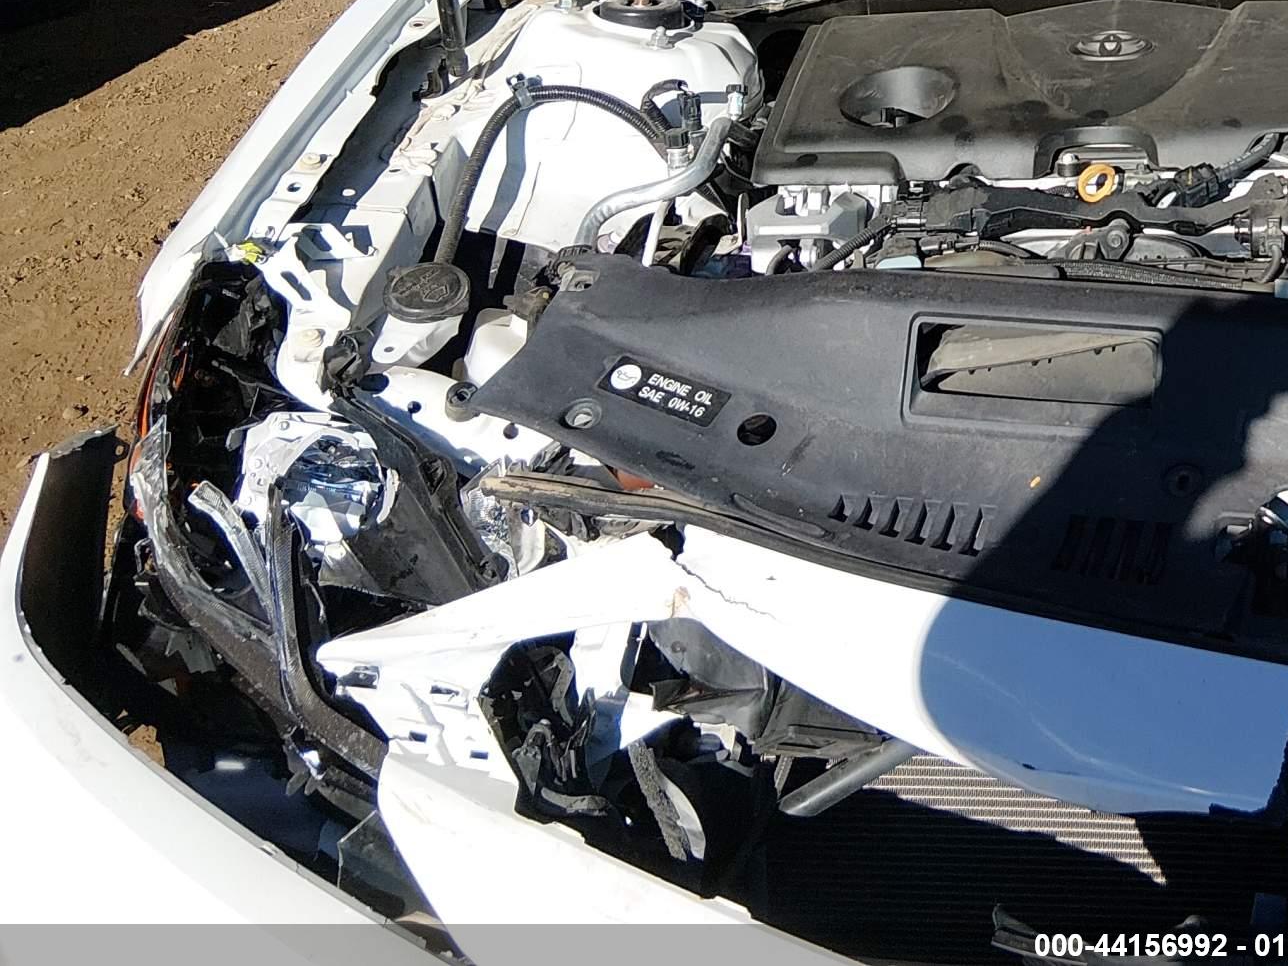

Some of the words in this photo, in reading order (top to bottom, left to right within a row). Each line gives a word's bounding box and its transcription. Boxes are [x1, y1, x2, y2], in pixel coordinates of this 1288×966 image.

[638, 386, 665, 403] SAE
[668, 396, 706, 418] 0W-16
[647, 373, 692, 397] ENGINE
[694, 390, 713, 406] OIL
